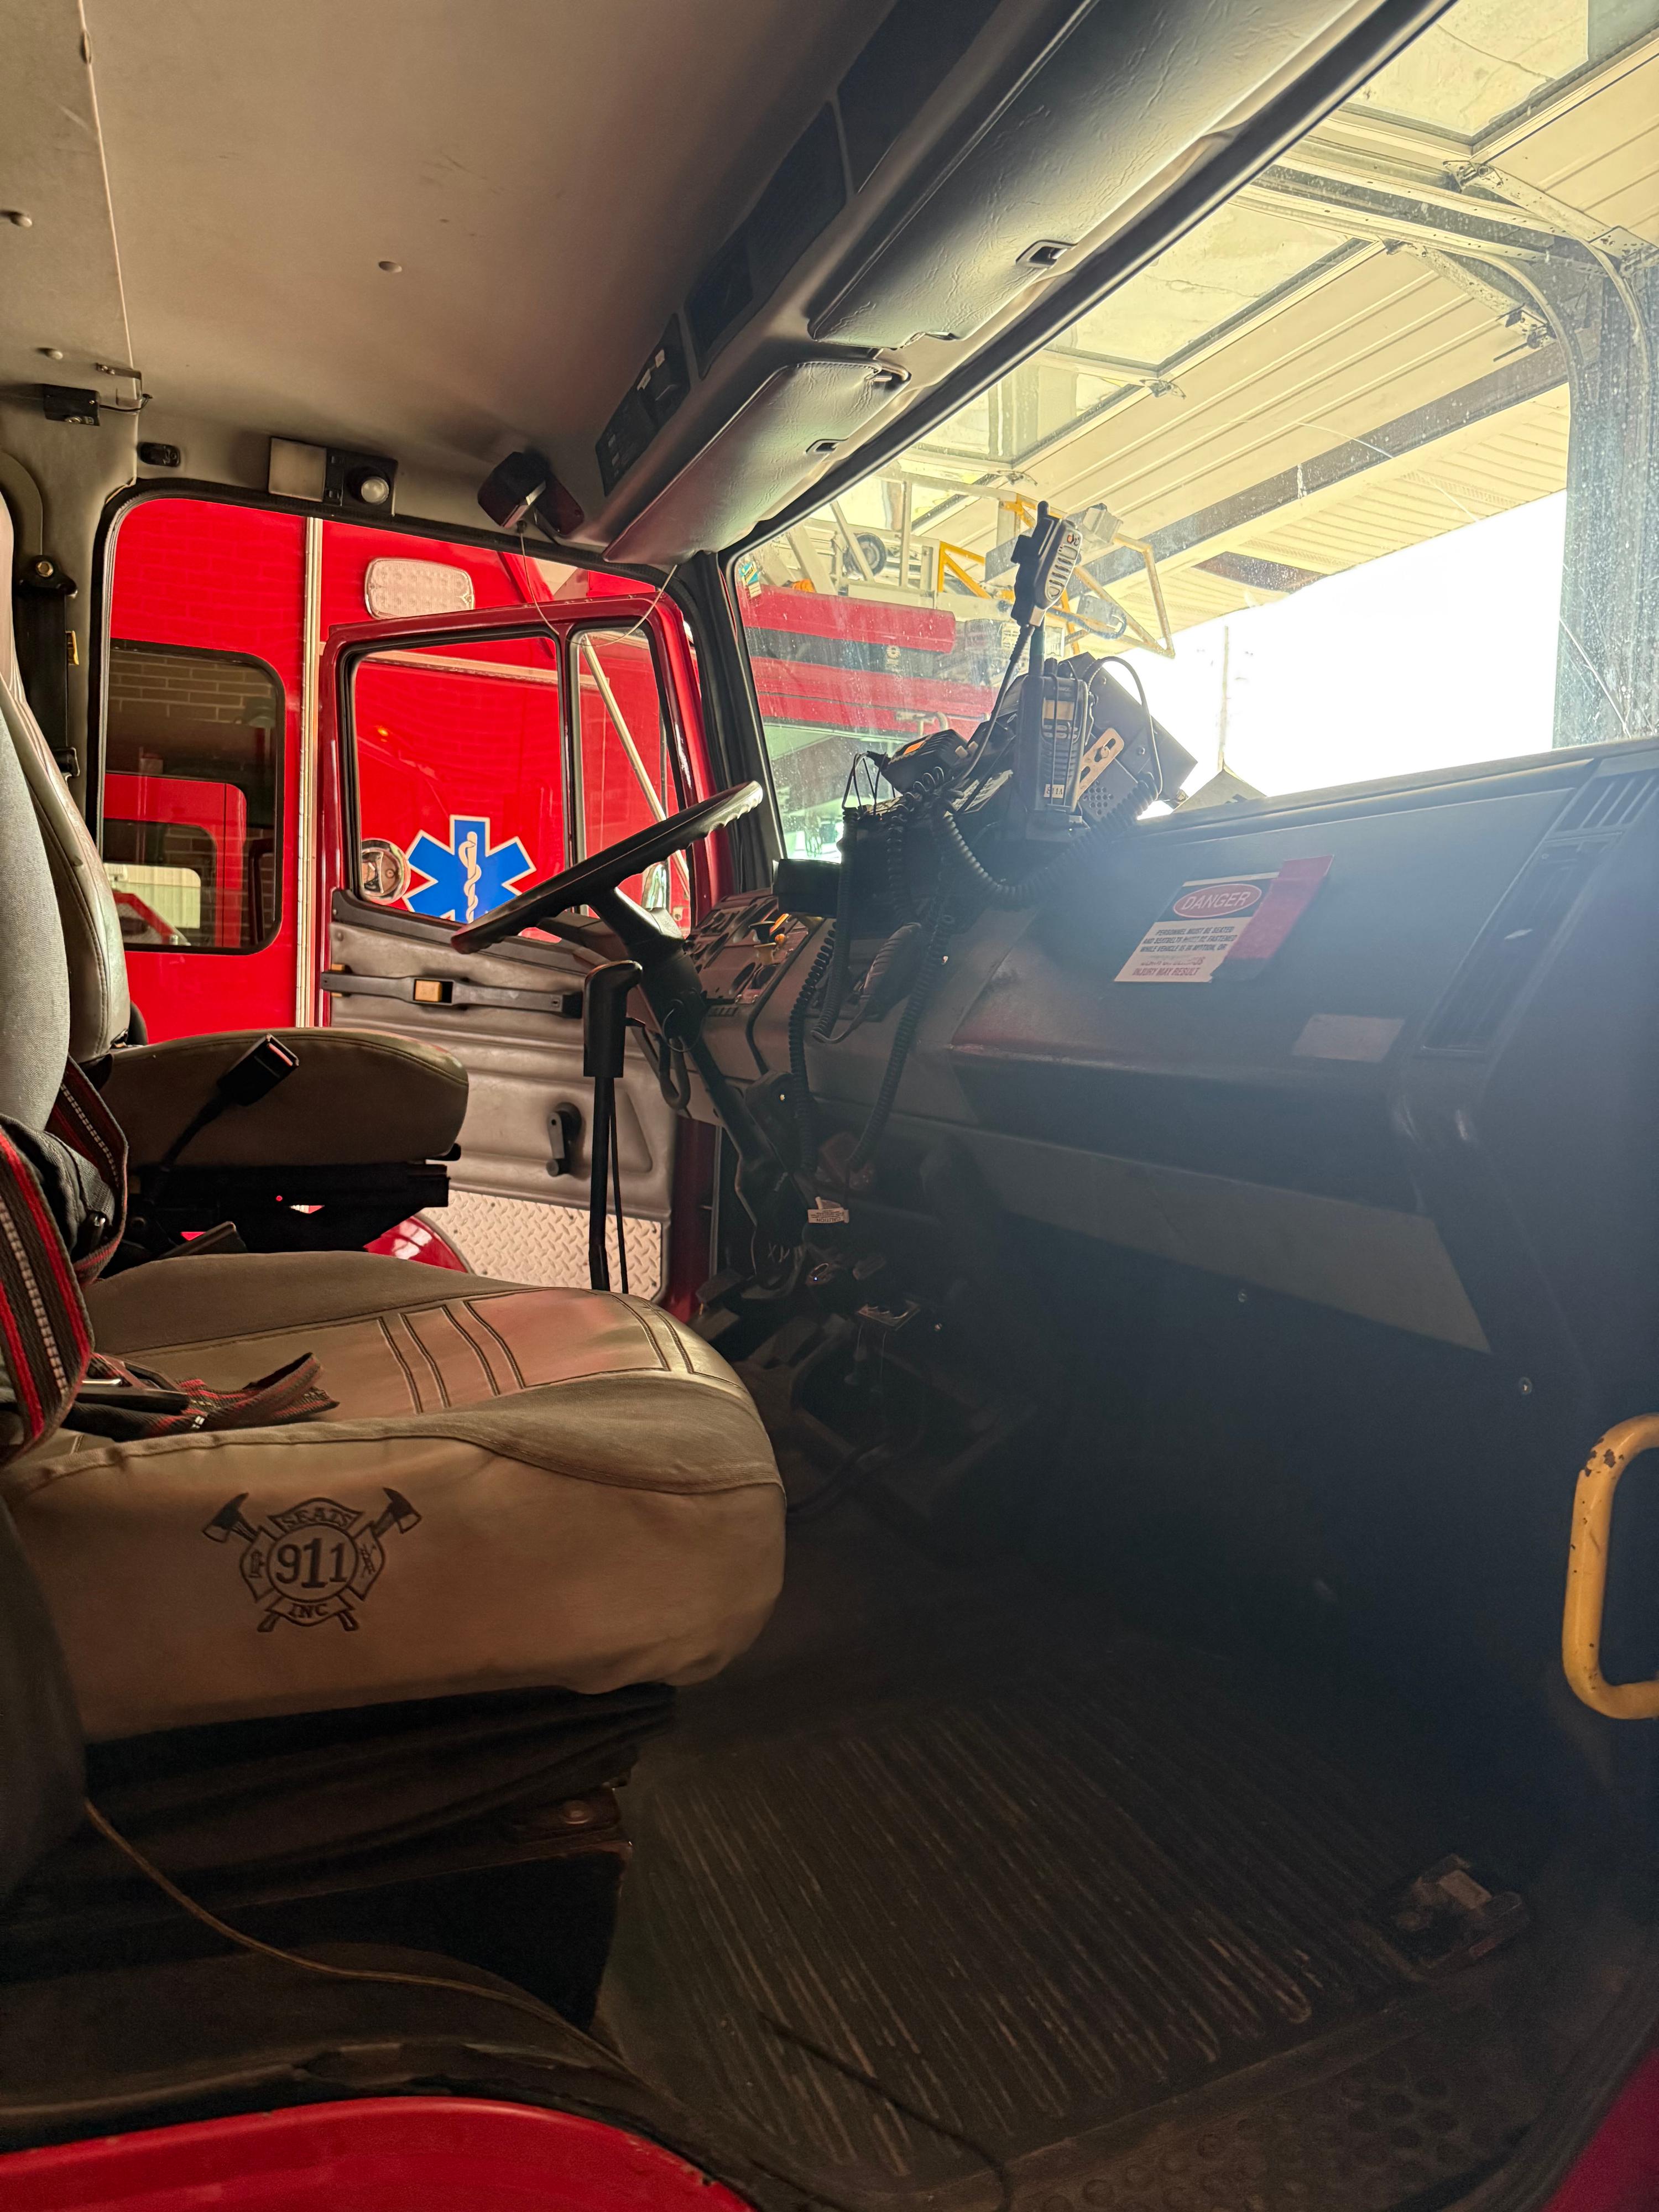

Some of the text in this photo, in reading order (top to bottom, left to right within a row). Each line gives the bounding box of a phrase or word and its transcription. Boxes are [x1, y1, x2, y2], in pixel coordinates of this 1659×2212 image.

[1181, 891, 1251, 910] DANGER
[1171, 967, 1200, 975] RESULT
[282, 1507, 353, 1530] SEATS
[276, 1537, 347, 1589] 911
[288, 1603, 329, 1618] INC
